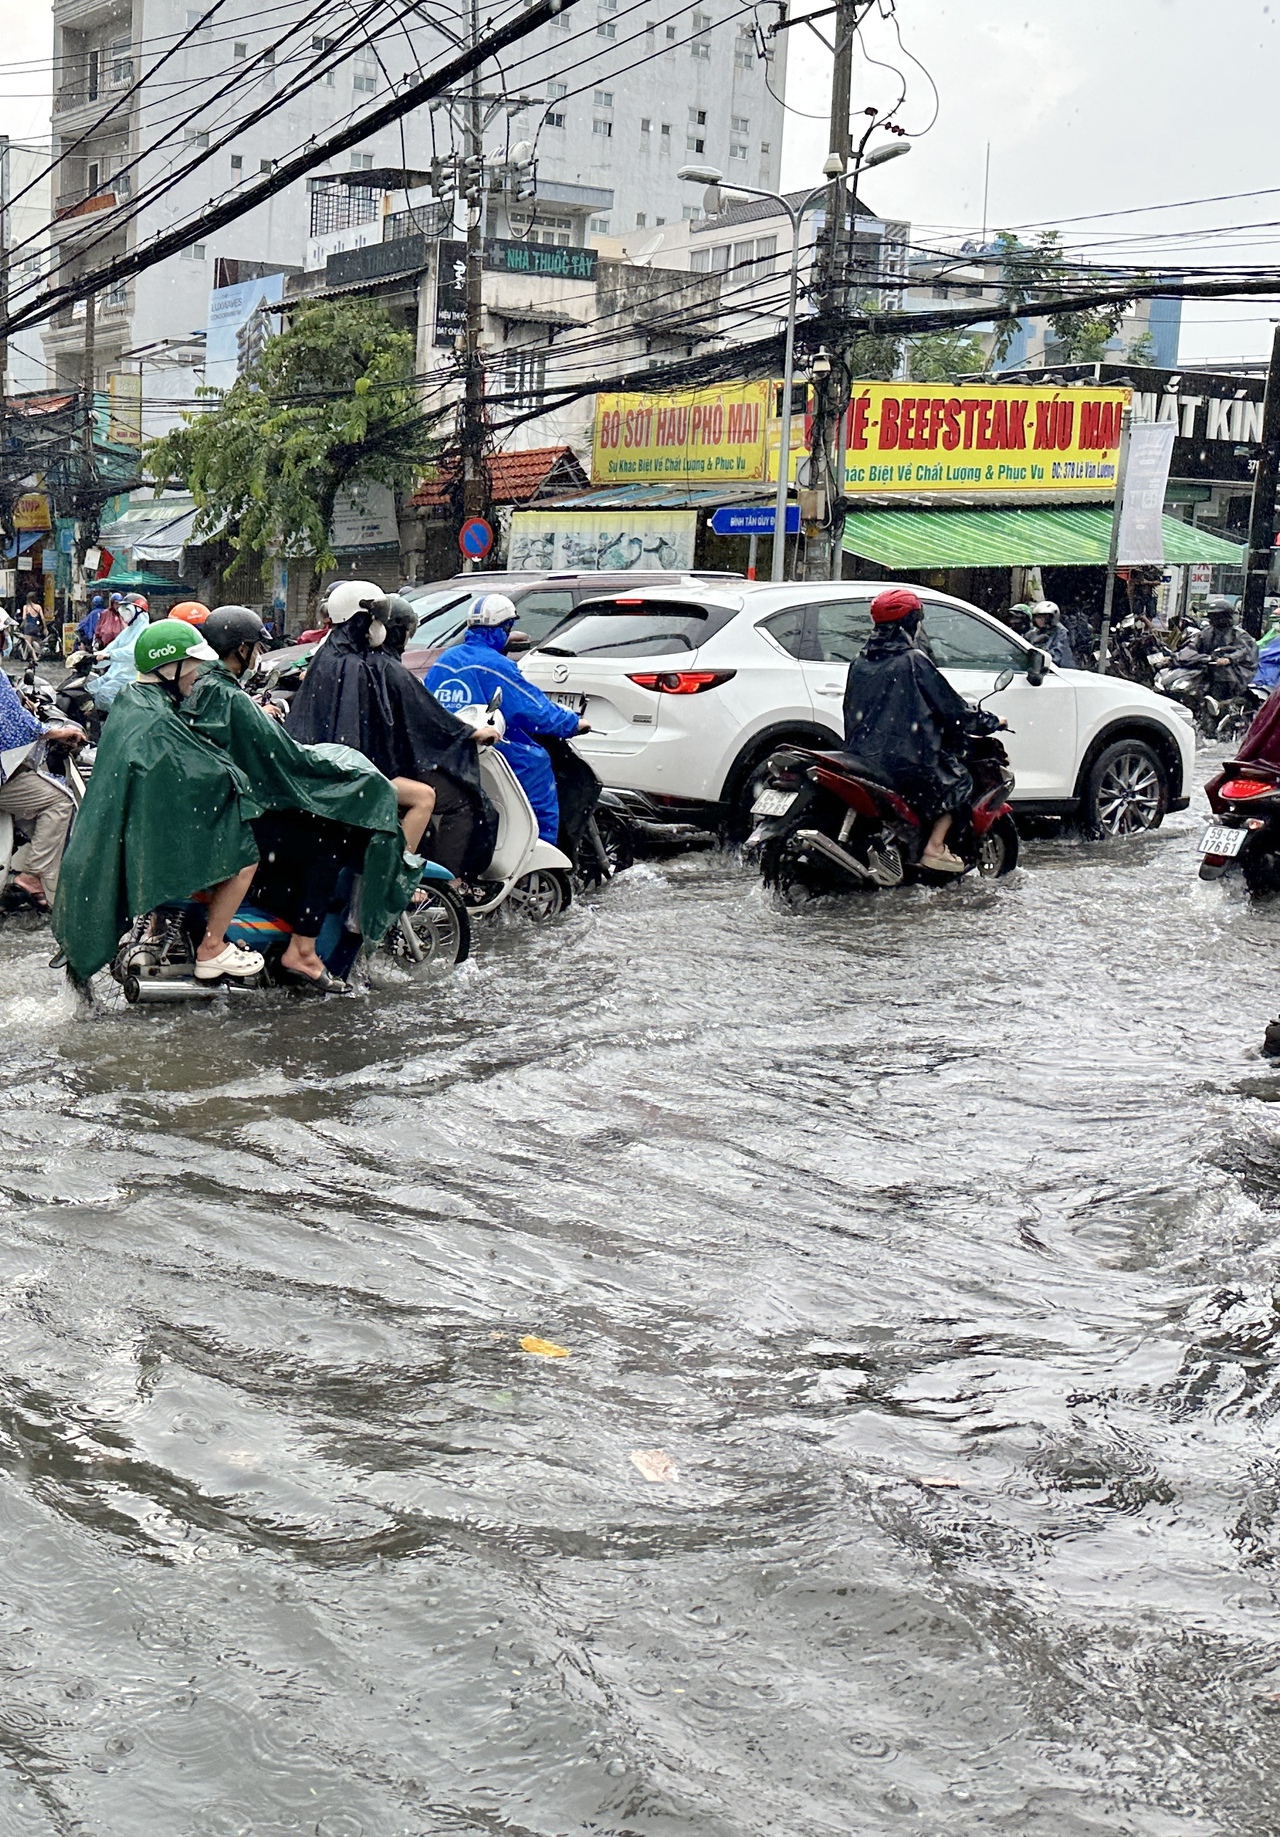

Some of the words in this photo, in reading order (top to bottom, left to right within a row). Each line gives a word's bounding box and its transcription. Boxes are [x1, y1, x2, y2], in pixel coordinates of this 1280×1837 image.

[506, 247, 530, 270] NHÀ
[532, 249, 570, 275] THUỐC
[572, 252, 594, 277] TÂY
[1130, 375, 1202, 438] MẮT
[600, 401, 620, 448] BÒ
[656, 398, 688, 447] HÀU
[691, 394, 724, 446] PHÔ
[727, 402, 760, 444] MAI
[1078, 401, 1123, 460] MẠI
[707, 456, 713, 470] &
[869, 464, 893, 485] Biệt
[897, 462, 912, 482] Về
[916, 461, 943, 482] Chất
[946, 464, 982, 484] Lượng
[985, 465, 994, 480] &
[998, 464, 1027, 484] Phục
[1030, 464, 1044, 483] Vụ
[1063, 461, 1075, 479] 378
[148, 644, 177, 660] Grab
[1209, 828, 1240, 842] 59-C3
